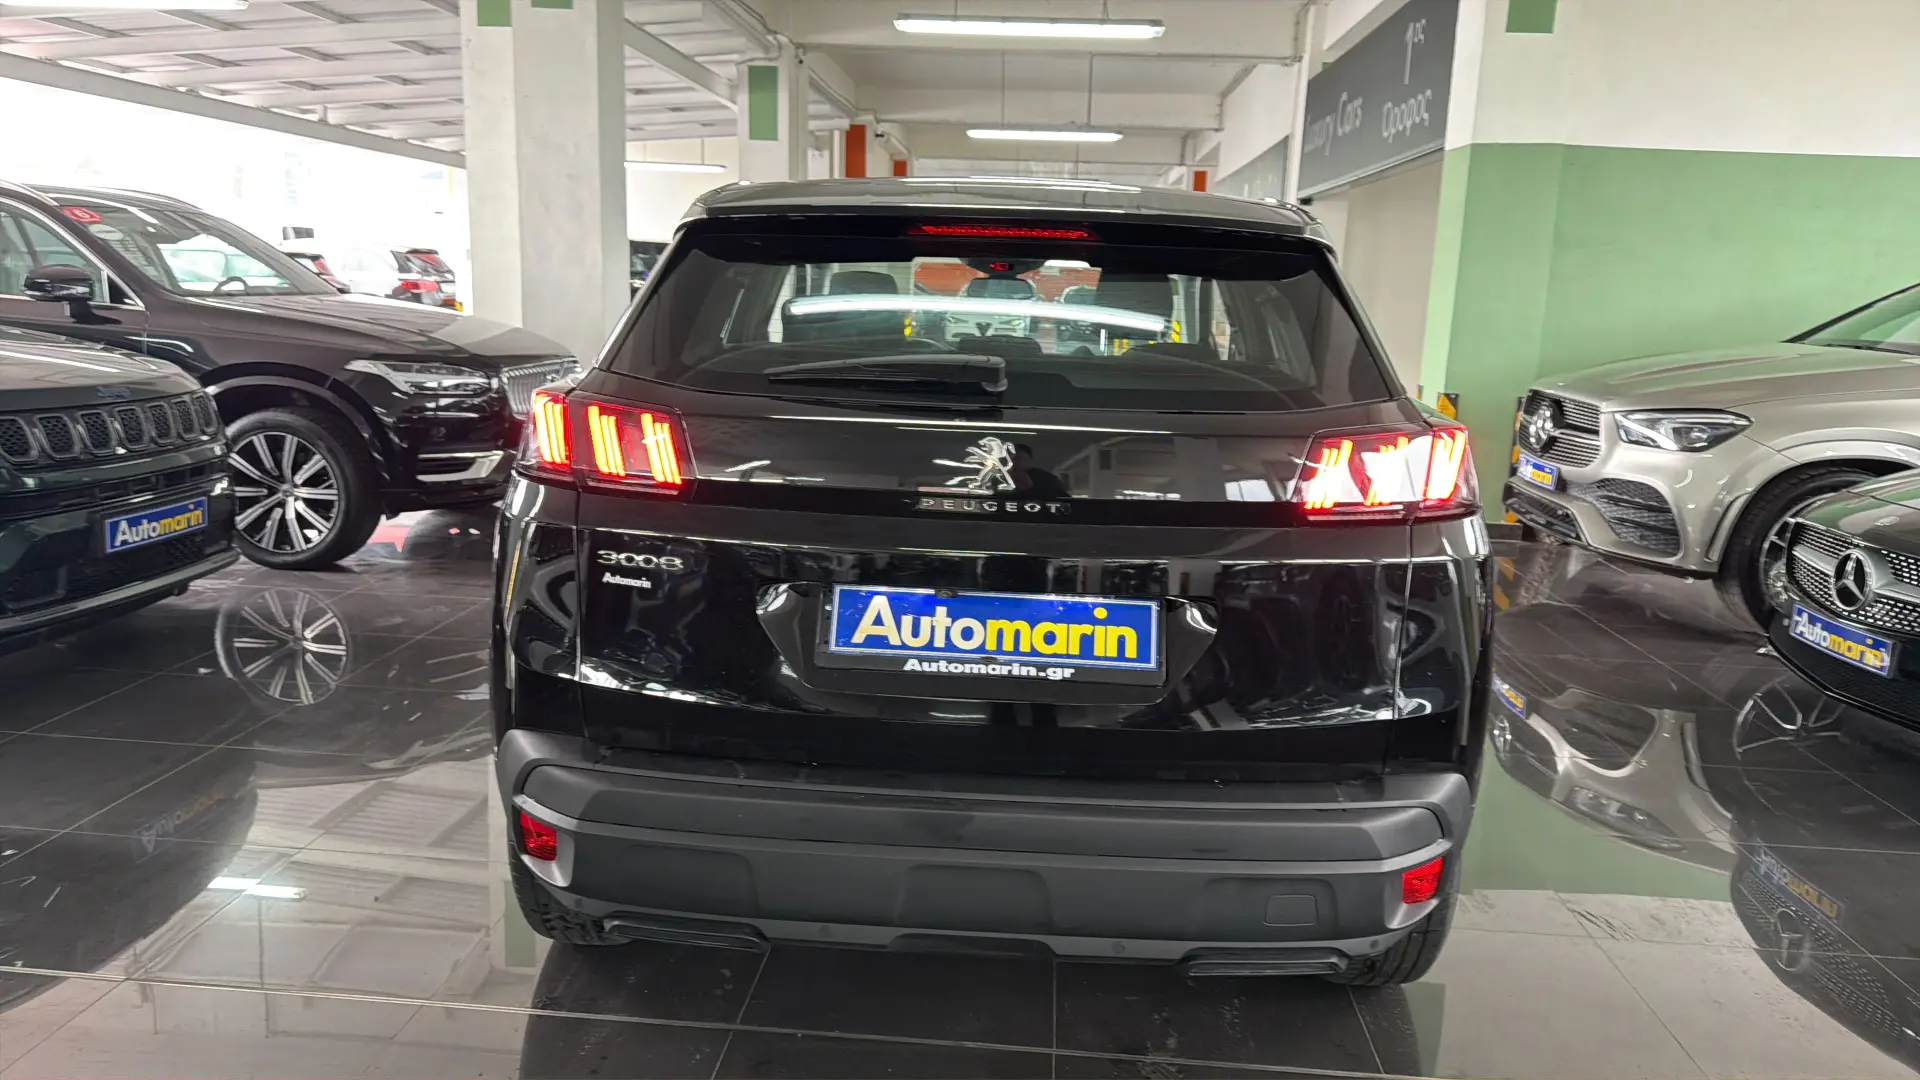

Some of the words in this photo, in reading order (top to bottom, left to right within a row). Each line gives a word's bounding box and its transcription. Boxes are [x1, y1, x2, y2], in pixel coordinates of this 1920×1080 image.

[1336, 91, 1363, 137] Cars
[917, 498, 1061, 514] PEUGEOT
[113, 503, 203, 547] Automarin
[596, 550, 684, 570] 3008
[851, 595, 1138, 659] Automarin
[903, 658, 1075, 681] Automarin.gr
